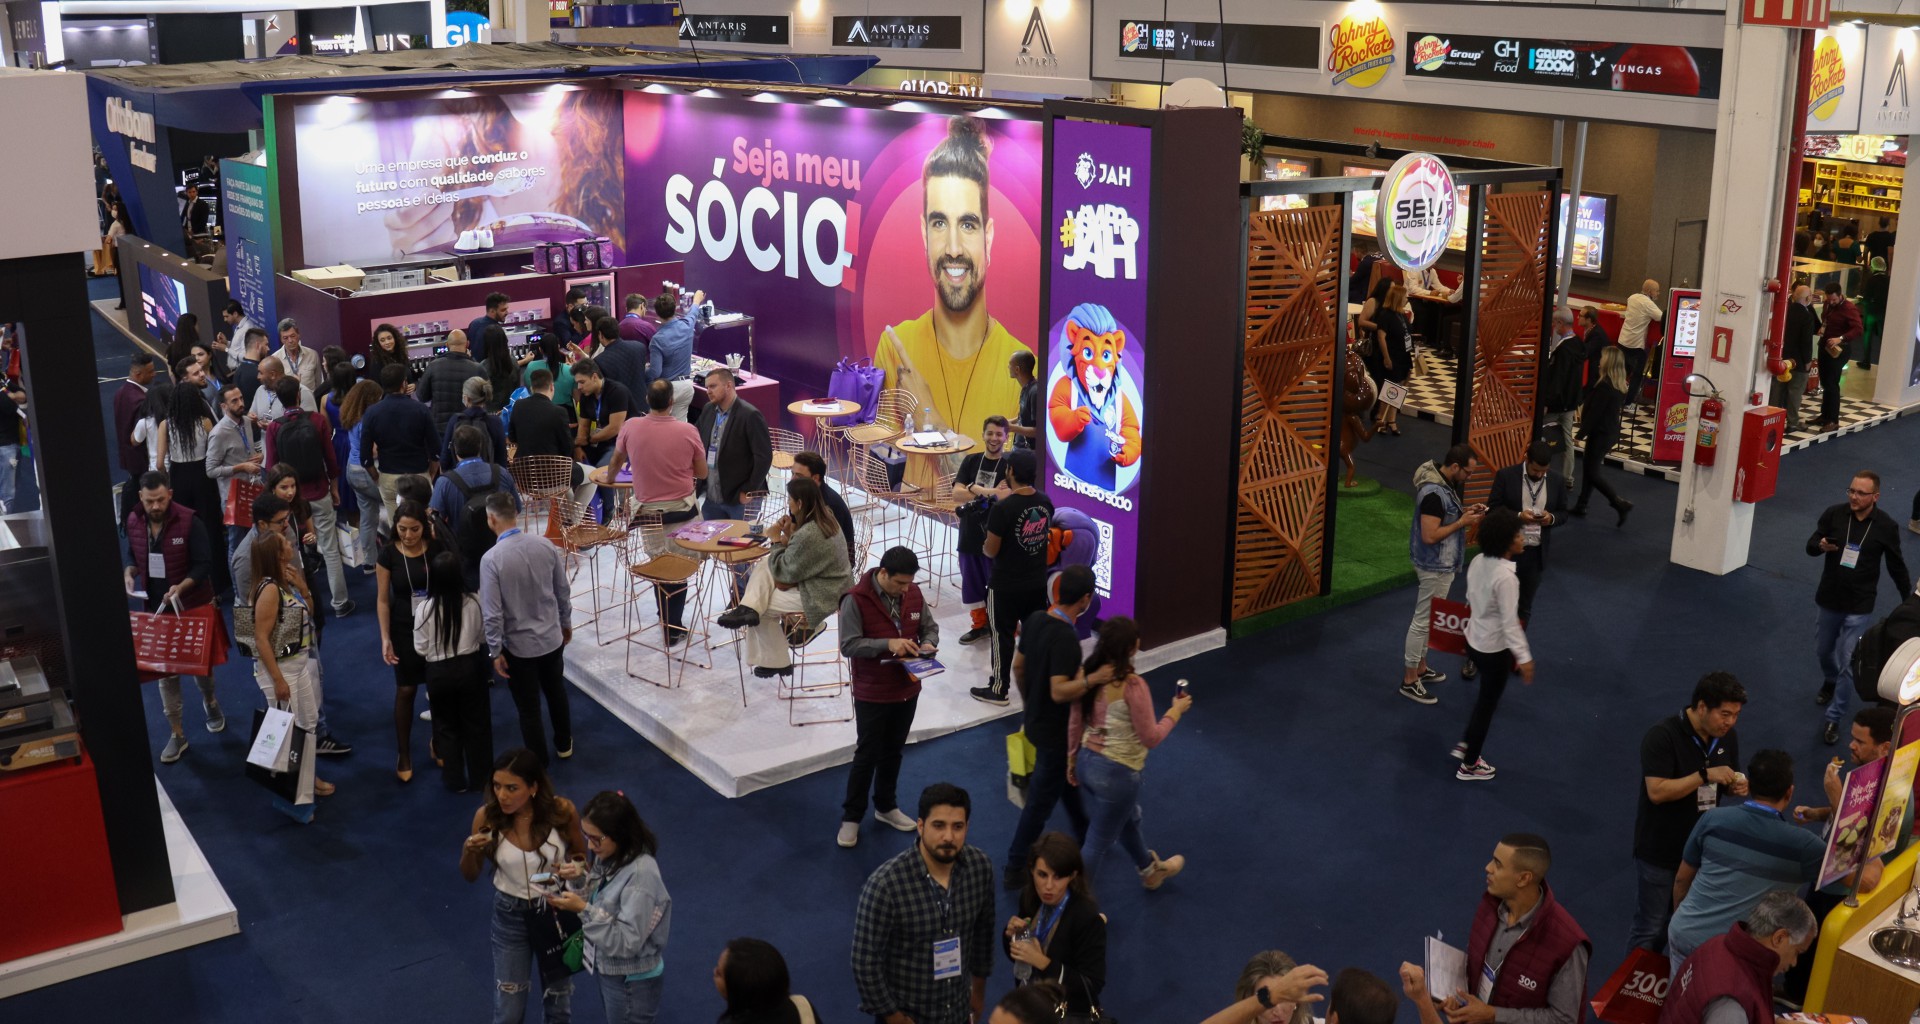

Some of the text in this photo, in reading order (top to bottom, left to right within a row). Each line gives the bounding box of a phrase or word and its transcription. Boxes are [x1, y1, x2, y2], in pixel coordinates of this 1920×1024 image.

[556, 0, 567, 11] BODY
[15, 19, 38, 39] JEWELS
[697, 21, 747, 31] ANTARIS
[871, 24, 930, 35] ANTARIS
[1190, 39, 1215, 48] YUNGAS
[1494, 40, 1519, 58] GH
[1015, 55, 1059, 67] ANTARIS
[1336, 34, 1395, 74] Rockets
[1535, 48, 1575, 61] GRUPO
[1494, 57, 1520, 73] Food
[1535, 59, 1575, 73] ZOOM
[1610, 63, 1662, 76] YUNGAS
[1876, 111, 1911, 121] ANTARIS
[1353, 127, 1382, 137] World's
[1383, 130, 1410, 140] largest
[1443, 136, 1472, 148] burger
[1472, 140, 1496, 150] chain
[354, 151, 528, 174] Uma empresa que conduz o
[732, 136, 861, 191] Seja meu
[355, 165, 546, 194] futuro com qualidade sabores
[1099, 163, 1131, 187] JAH
[356, 191, 460, 215] pessoas e ideias
[1664, 434, 1686, 442] EXPRE
[1518, 974, 1537, 989] 300
[1624, 970, 1669, 999] 300
[1620, 988, 1664, 1007] FRANCHISING
